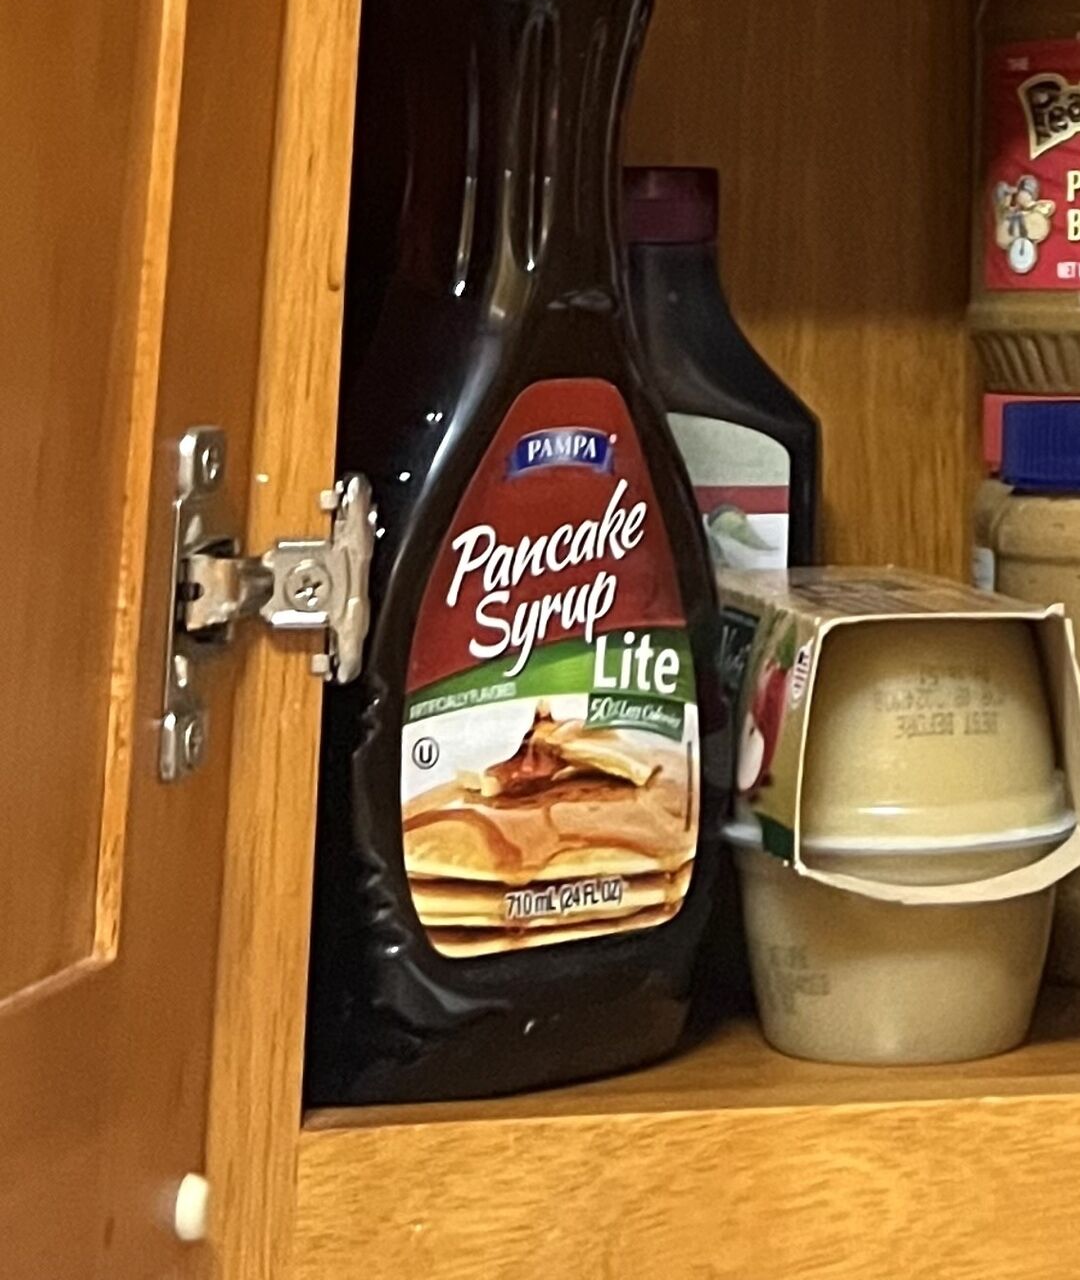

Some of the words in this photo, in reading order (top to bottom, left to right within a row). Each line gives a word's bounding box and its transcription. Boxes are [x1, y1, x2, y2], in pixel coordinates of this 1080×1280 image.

[527, 434, 597, 463] PAMPA
[445, 478, 648, 608] Pancake
[468, 571, 617, 678] Syrup
[593, 631, 681, 695] Lite
[506, 892, 533, 918] 710
